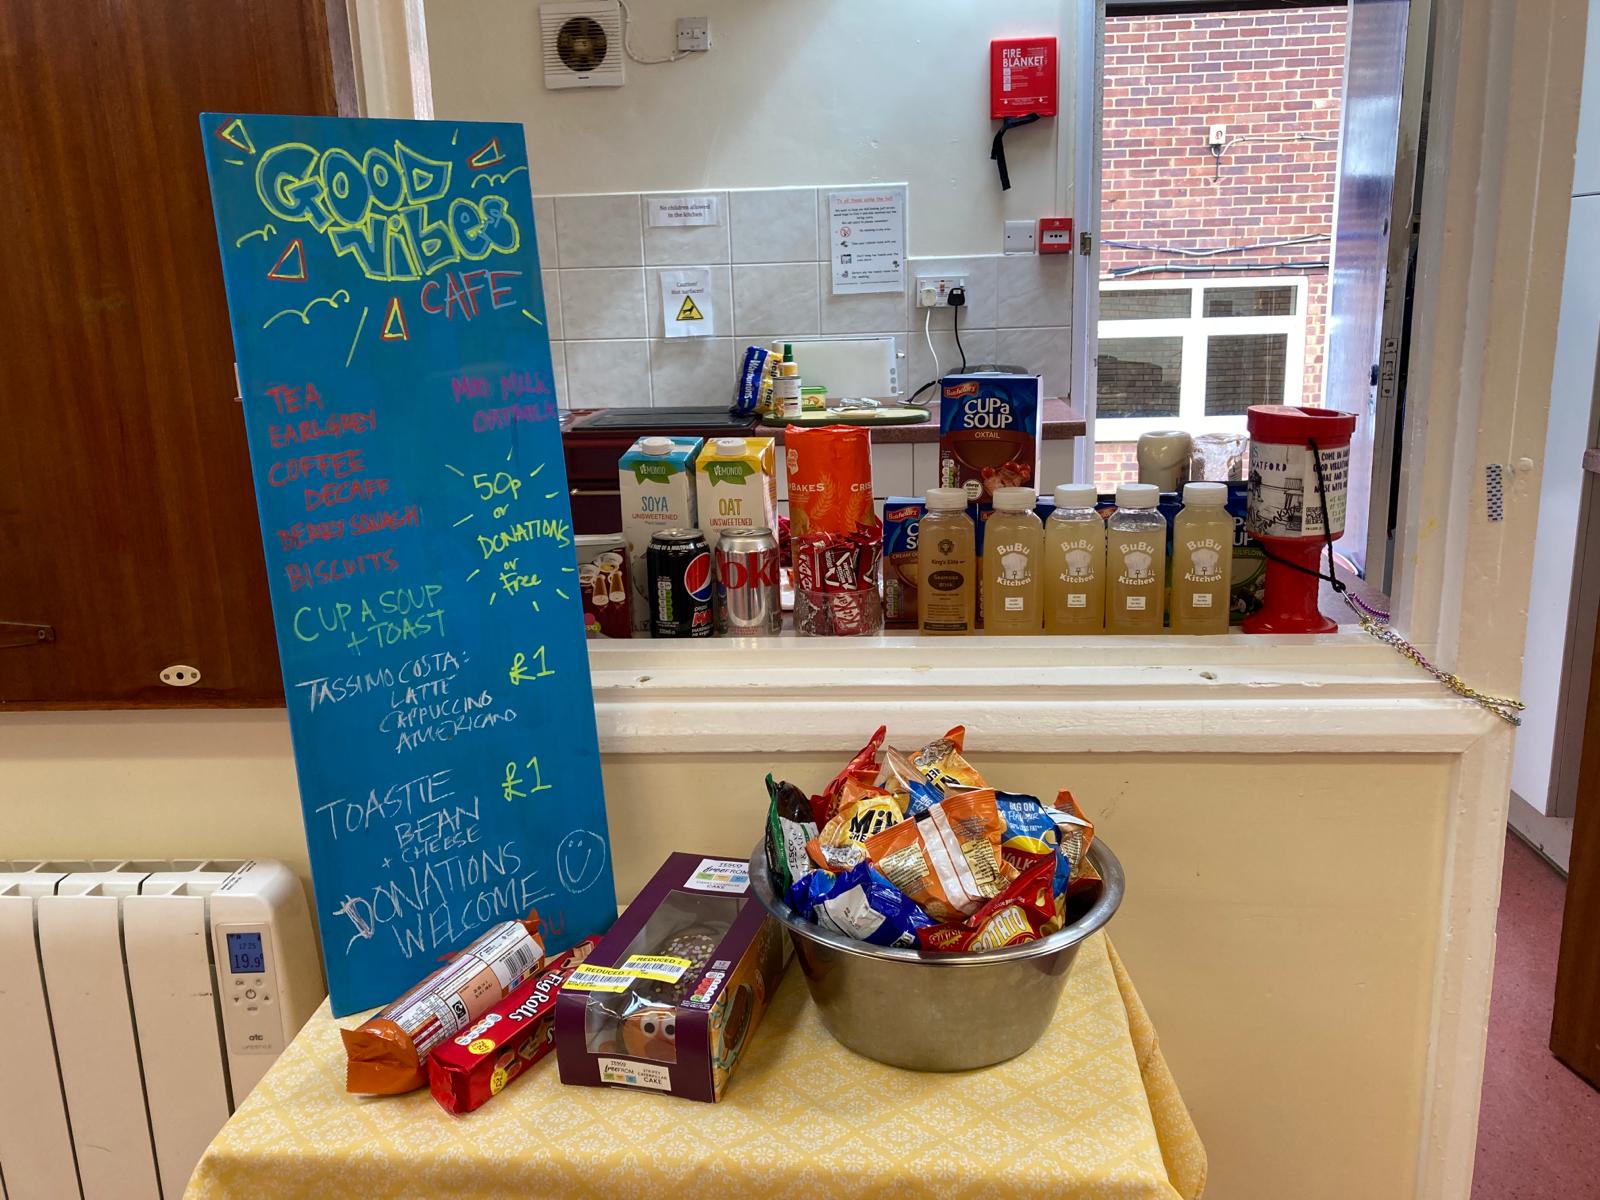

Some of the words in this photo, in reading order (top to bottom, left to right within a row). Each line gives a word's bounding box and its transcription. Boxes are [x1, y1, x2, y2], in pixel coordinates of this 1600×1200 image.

[1002, 48, 1022, 58] FIRE
[1002, 56, 1044, 67] BLANKET
[255, 139, 452, 233] GOOD
[420, 270, 522, 321] CAFE
[265, 383, 324, 415] TEA
[963, 413, 1013, 429] SOUP
[975, 431, 1001, 439] OXTAIL
[268, 449, 365, 487] COFFEE
[714, 464, 743, 476] VEMONDO
[1313, 463, 1328, 472] GOD
[473, 471, 521, 500] 50p
[789, 482, 825, 492] BAKES
[303, 479, 389, 512] DECAFF
[493, 504, 509, 518] or
[641, 496, 668, 513] SOYA
[719, 498, 742, 516] OAT
[710, 518, 752, 526] UNSWEETENED
[277, 518, 345, 552] BERRY
[476, 519, 570, 560] DONATIONS
[996, 543, 1031, 556] BuBu
[1060, 540, 1095, 552] BuBu
[1119, 541, 1154, 554] BuBu
[1186, 539, 1222, 551] BuBu
[286, 549, 399, 592] BISCUITS
[503, 558, 518, 571] or
[996, 576, 1031, 587] Kitchen
[1059, 573, 1095, 583] Kitchen
[1118, 575, 1155, 586] Kitchen
[1184, 573, 1222, 583] Kitchen
[294, 601, 351, 641] CUP
[361, 600, 375, 624] A
[379, 584, 442, 615] SOUP
[368, 608, 445, 649] TOAST
[296, 667, 394, 712] TASSIMO
[391, 675, 456, 708] LATTE
[395, 709, 518, 754] AMERICANO
[316, 769, 455, 840] TOASTIE
[1023, 801, 1035, 811] ON
[395, 796, 480, 848] BEAN
[401, 822, 482, 864] CHEESE
[788, 839, 796, 868] TESCO
[332, 842, 521, 942] DONATIONS
[391, 871, 555, 960] WELCOME
[637, 956, 676, 964] REDUCED
[585, 967, 625, 975] REDUCED
[536, 973, 563, 992] Fig
[508, 990, 550, 1022] Rolls
[643, 1077, 662, 1085] CAKE
